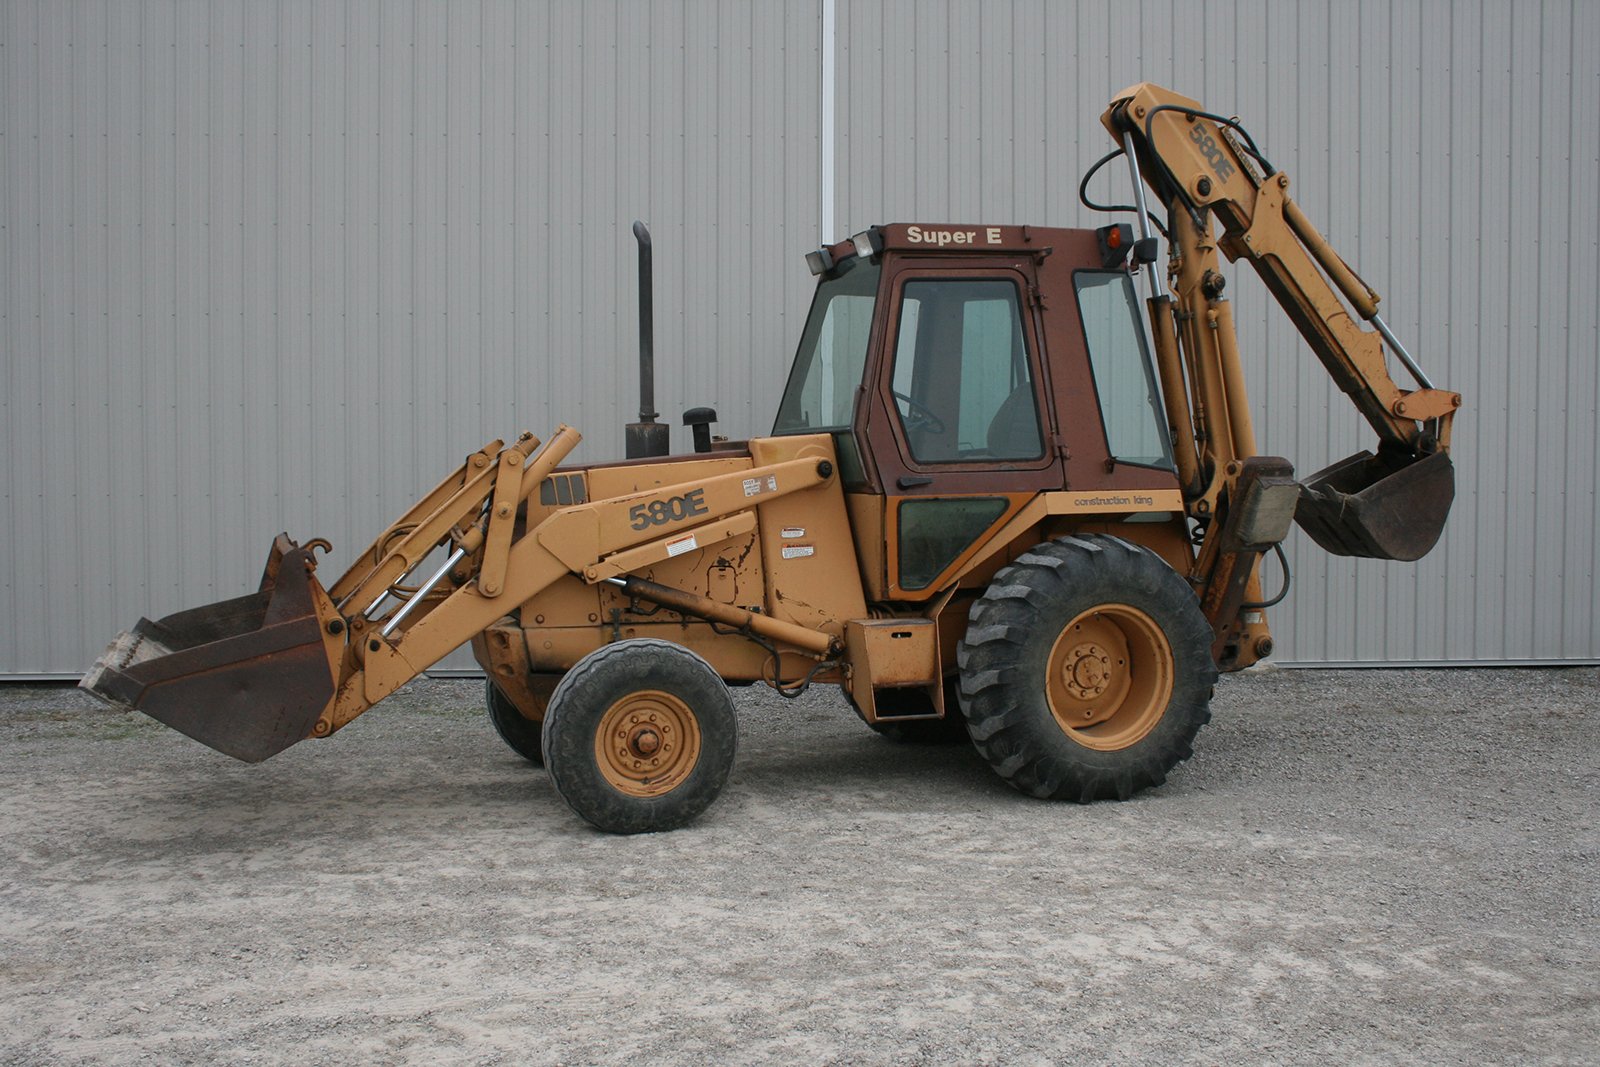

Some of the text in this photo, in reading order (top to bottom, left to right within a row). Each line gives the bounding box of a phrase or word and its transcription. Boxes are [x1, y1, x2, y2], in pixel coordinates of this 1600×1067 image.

[1190, 122, 1235, 184] 580E
[907, 226, 1002, 246] Super E
[629, 488, 708, 530] 580E
[1074, 496, 1153, 506] construction king
